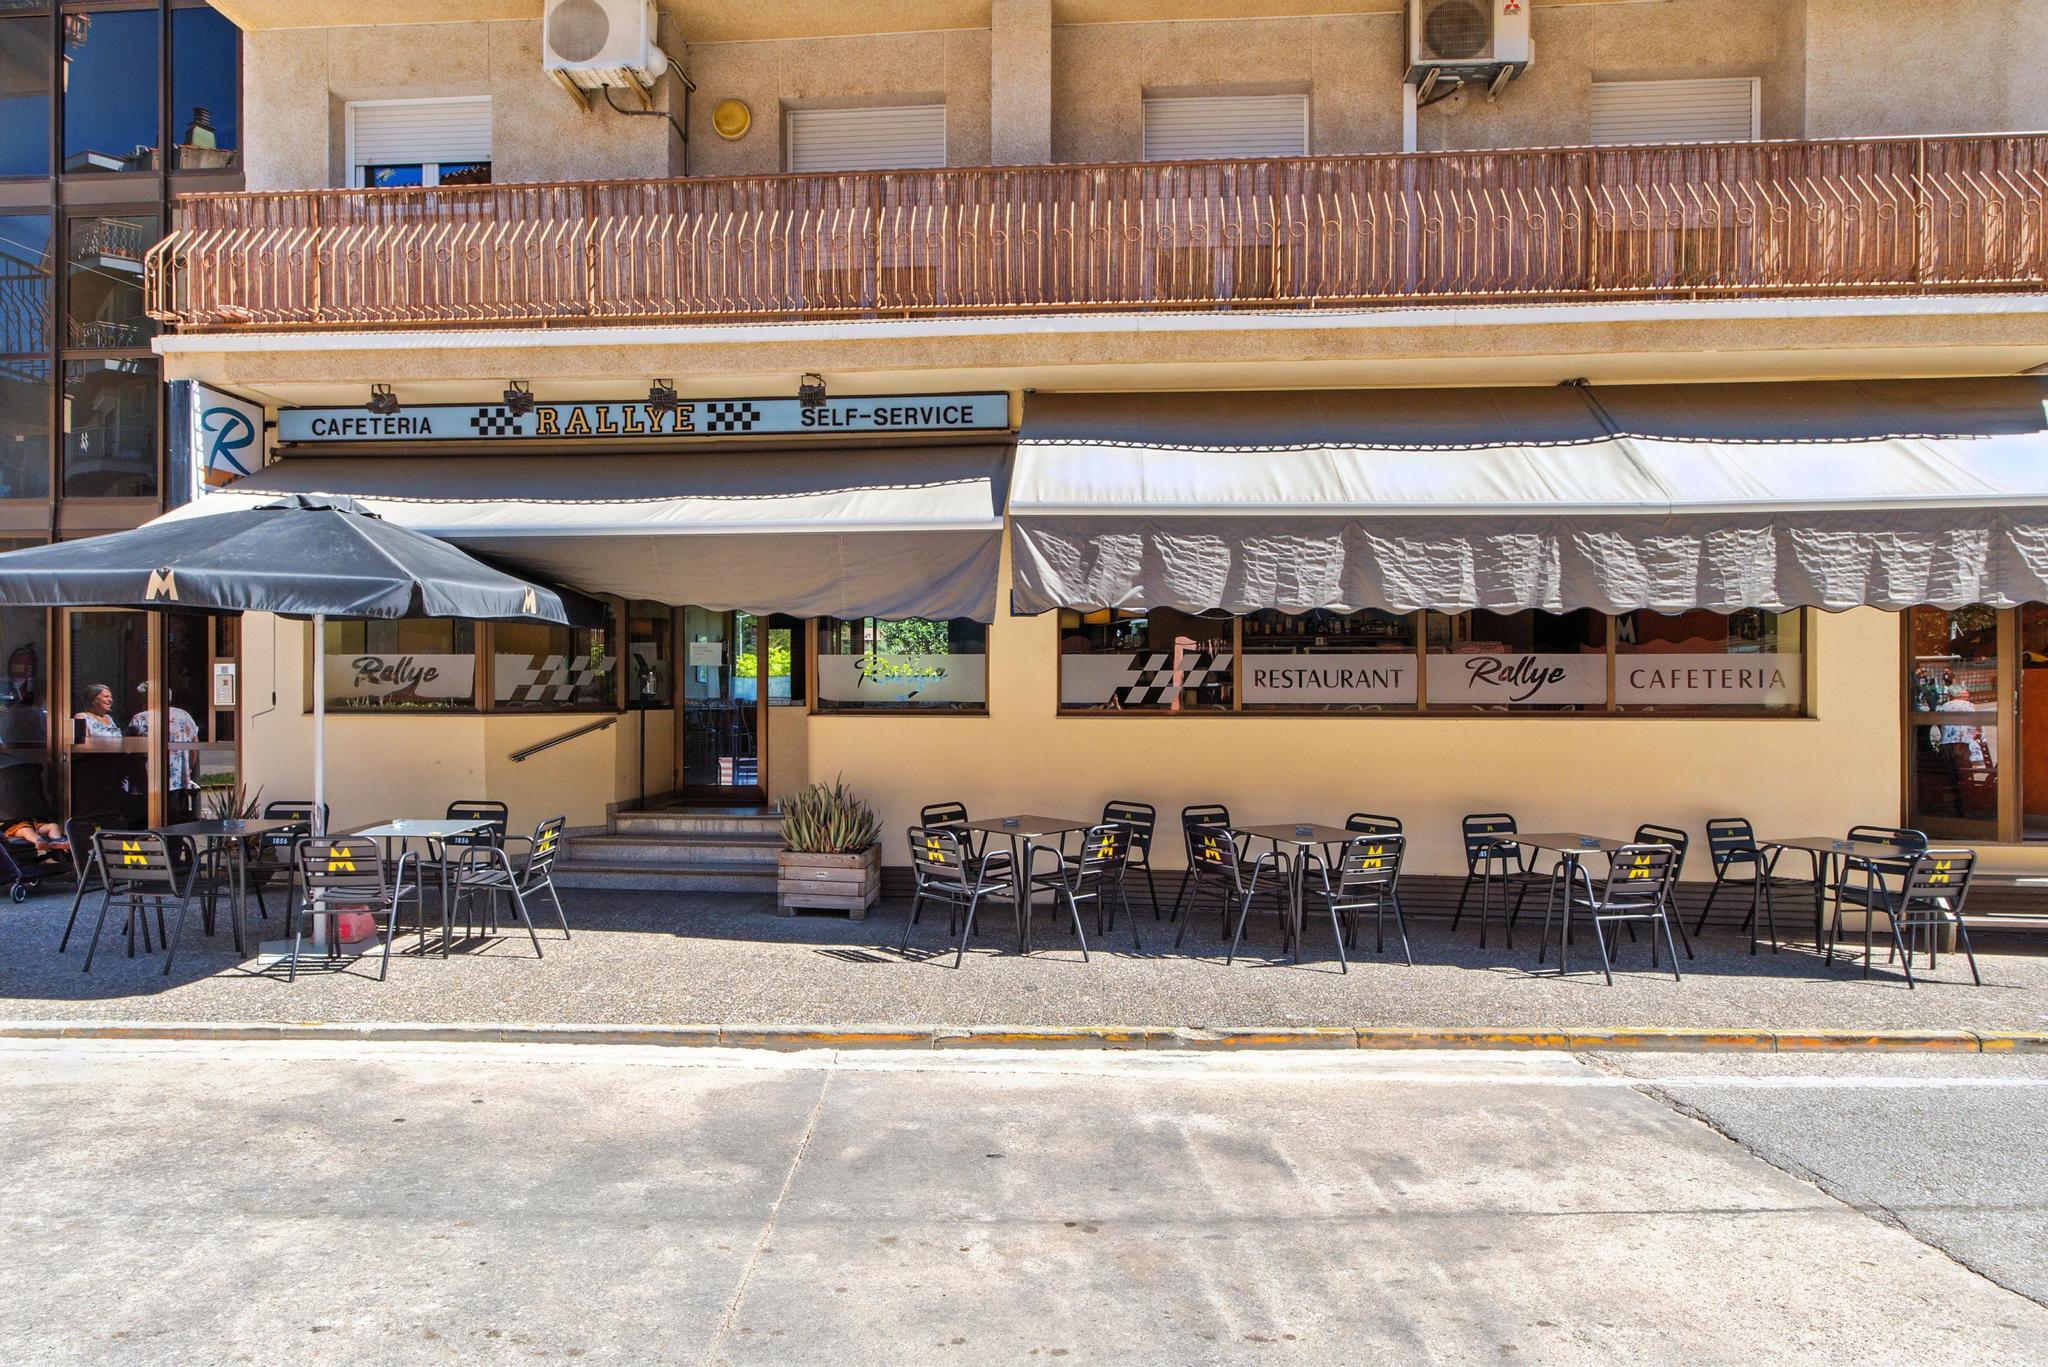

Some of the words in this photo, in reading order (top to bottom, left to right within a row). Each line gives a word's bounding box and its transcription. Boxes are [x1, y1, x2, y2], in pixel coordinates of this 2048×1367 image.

[311, 416, 432, 436] CAFETERIA
[535, 403, 695, 436] RALLYE
[800, 405, 974, 427] SELF-SERVICE
[201, 406, 255, 477] R
[352, 655, 439, 700] Rallye
[1253, 669, 1404, 690] RESTAURANT
[1464, 655, 1567, 702] Rallye
[1629, 668, 1786, 690] CAFETERIA
[272, 837, 288, 845] 1856
